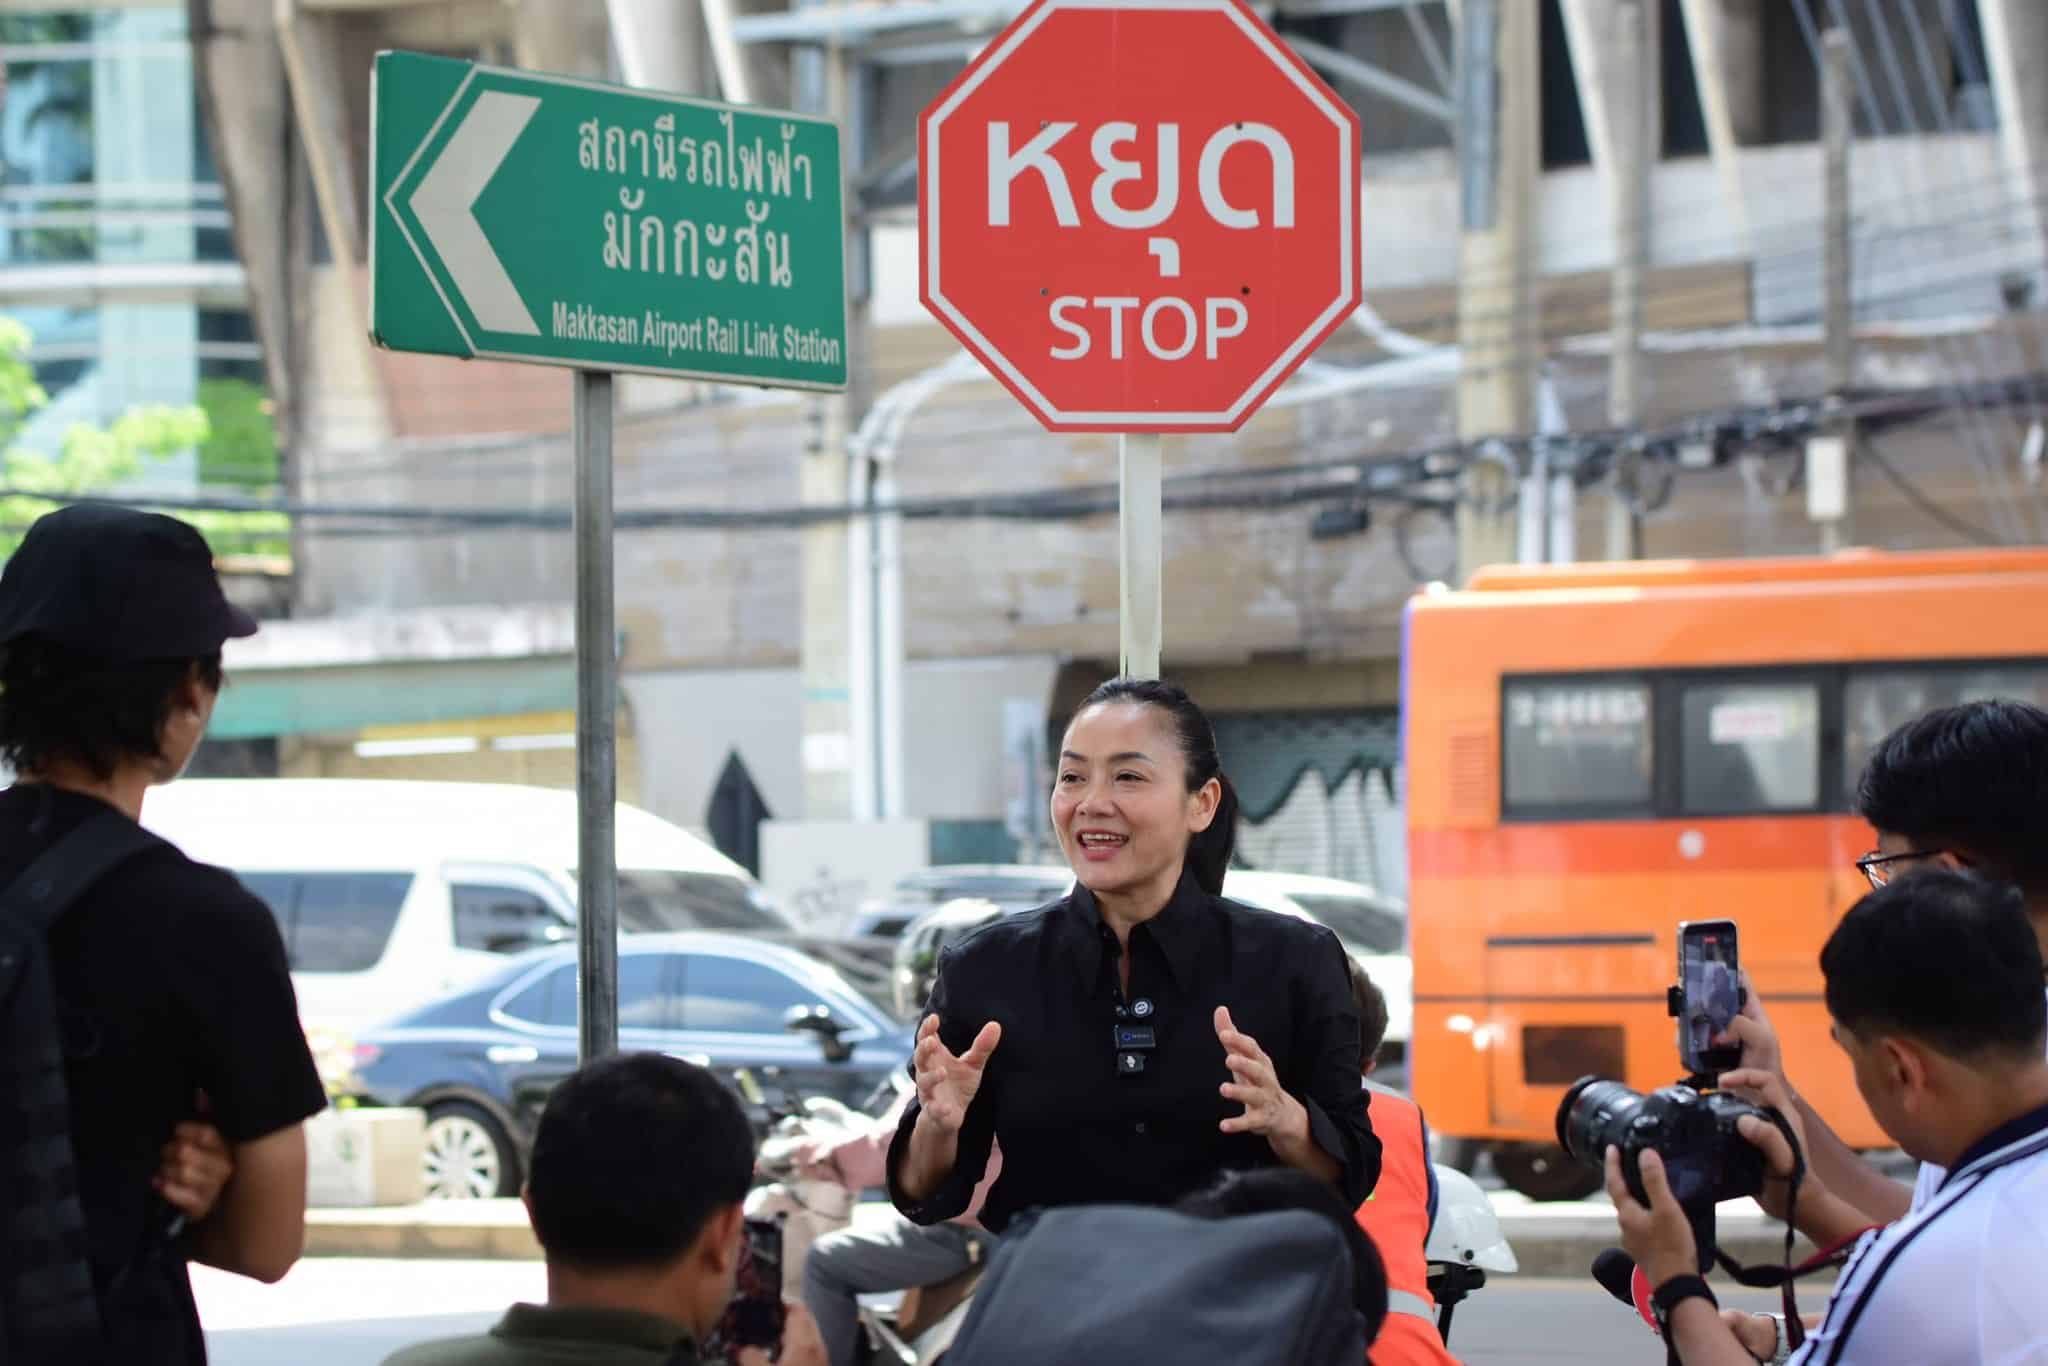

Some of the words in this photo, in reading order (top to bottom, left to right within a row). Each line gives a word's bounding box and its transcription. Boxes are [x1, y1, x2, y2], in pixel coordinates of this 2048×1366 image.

[579, 111, 812, 200] สถานีรถไฟฟ้า
[987, 121, 1295, 277] หยุด
[603, 186, 792, 287] มักกะสัน
[552, 301, 638, 345] Makkasan
[643, 311, 703, 357] Airport
[707, 316, 739, 355] Rail
[744, 320, 779, 359] Link
[783, 325, 840, 365] Station
[1049, 296, 1249, 360] STOP
